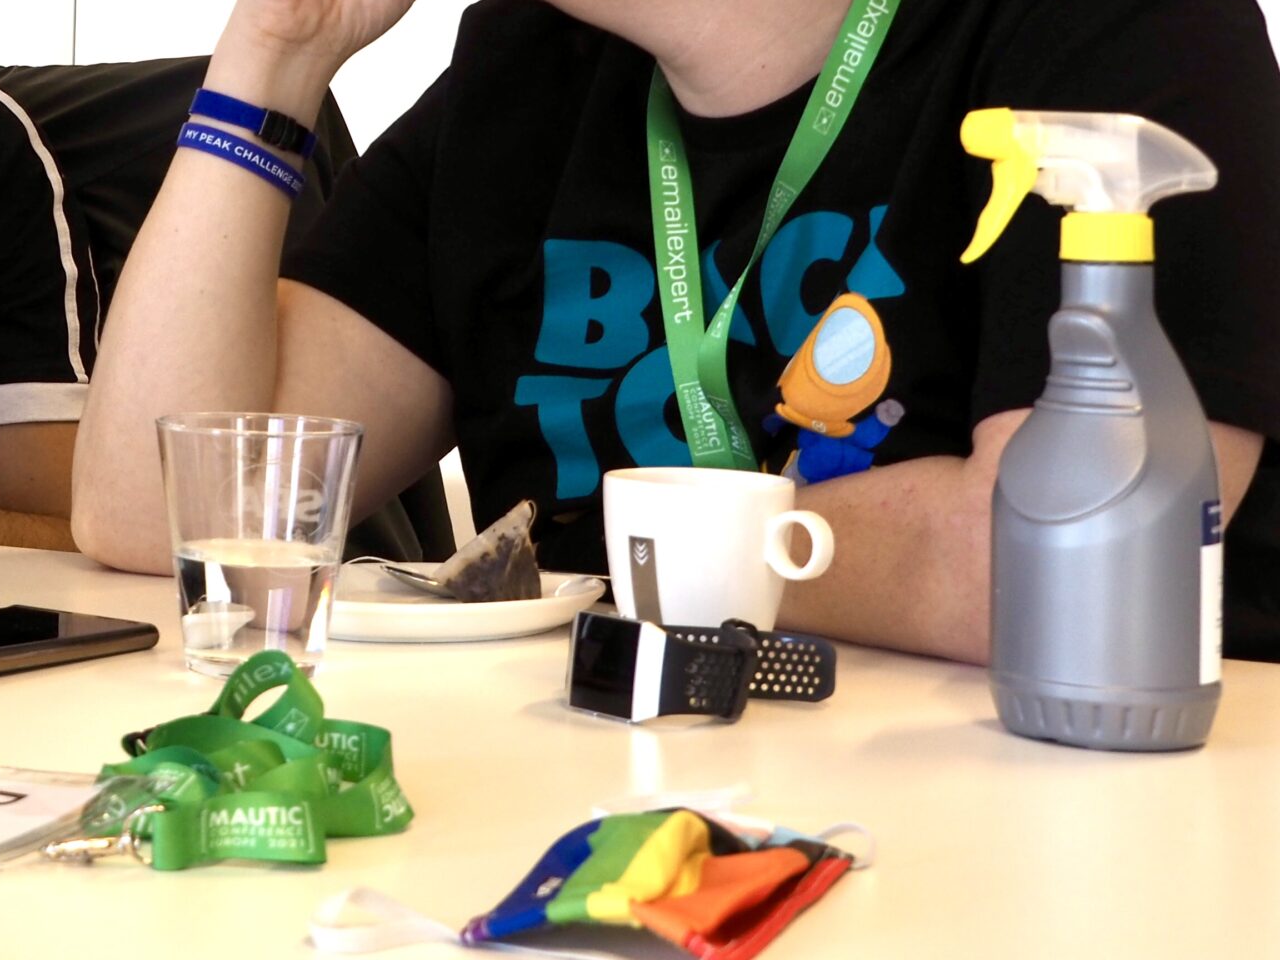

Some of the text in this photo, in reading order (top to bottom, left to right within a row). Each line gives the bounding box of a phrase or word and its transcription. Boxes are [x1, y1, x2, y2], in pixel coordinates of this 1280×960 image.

[185, 129, 293, 185] MY PEAK CHALLENGE
[661, 165, 693, 324] emailexpert
[209, 806, 303, 827] MAUTIC
[209, 825, 303, 837] CONFERENCE
